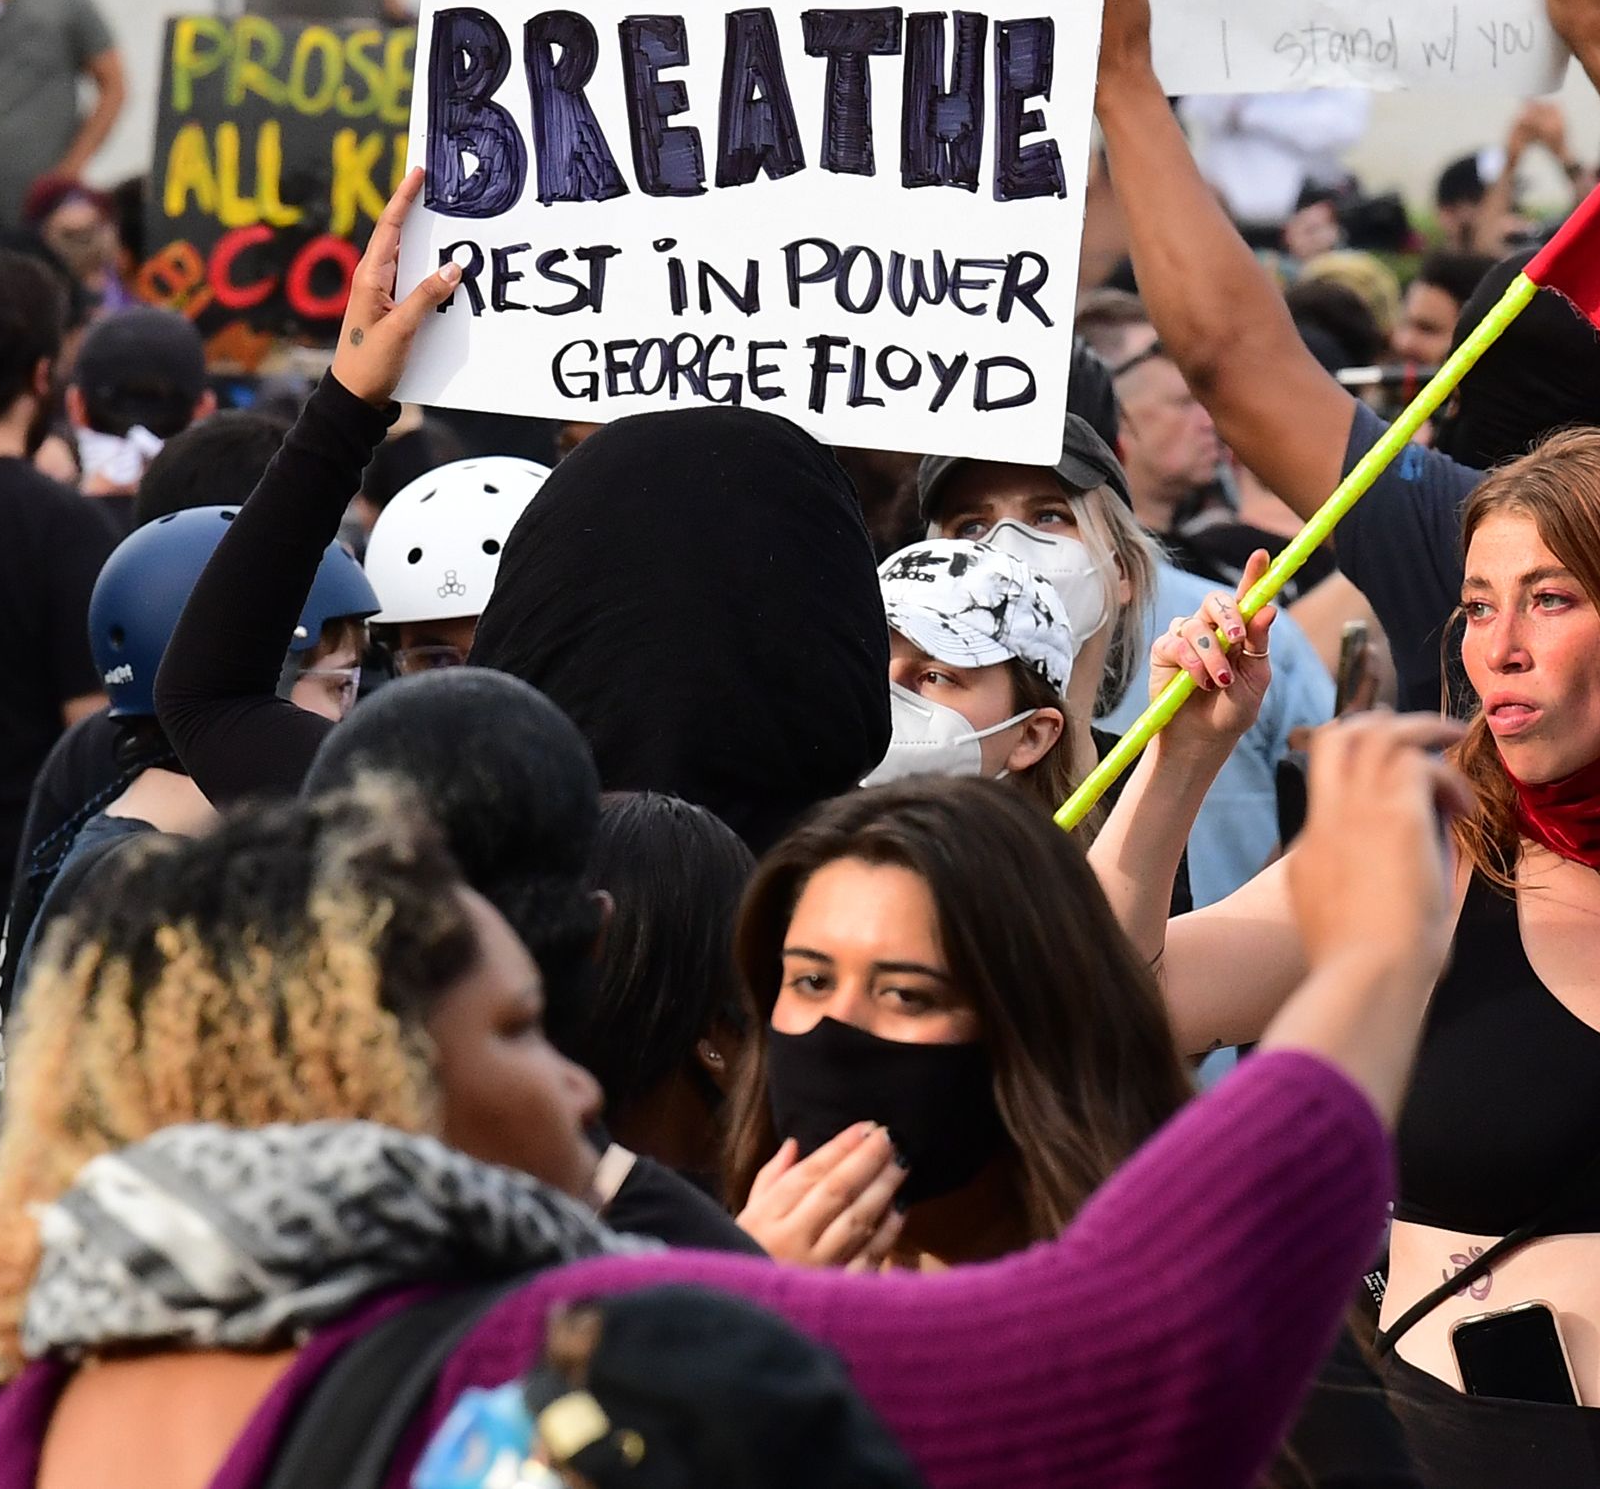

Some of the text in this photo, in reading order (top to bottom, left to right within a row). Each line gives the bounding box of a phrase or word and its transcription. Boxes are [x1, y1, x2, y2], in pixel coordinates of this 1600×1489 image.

[1273, 16, 1398, 76] stand
[423, 7, 1068, 218] BREATHE
[164, 120, 303, 228] ALL
[437, 240, 622, 317] REST
[780, 237, 1055, 327] POWER
[551, 332, 1037, 414] GEORGE FLOYD
